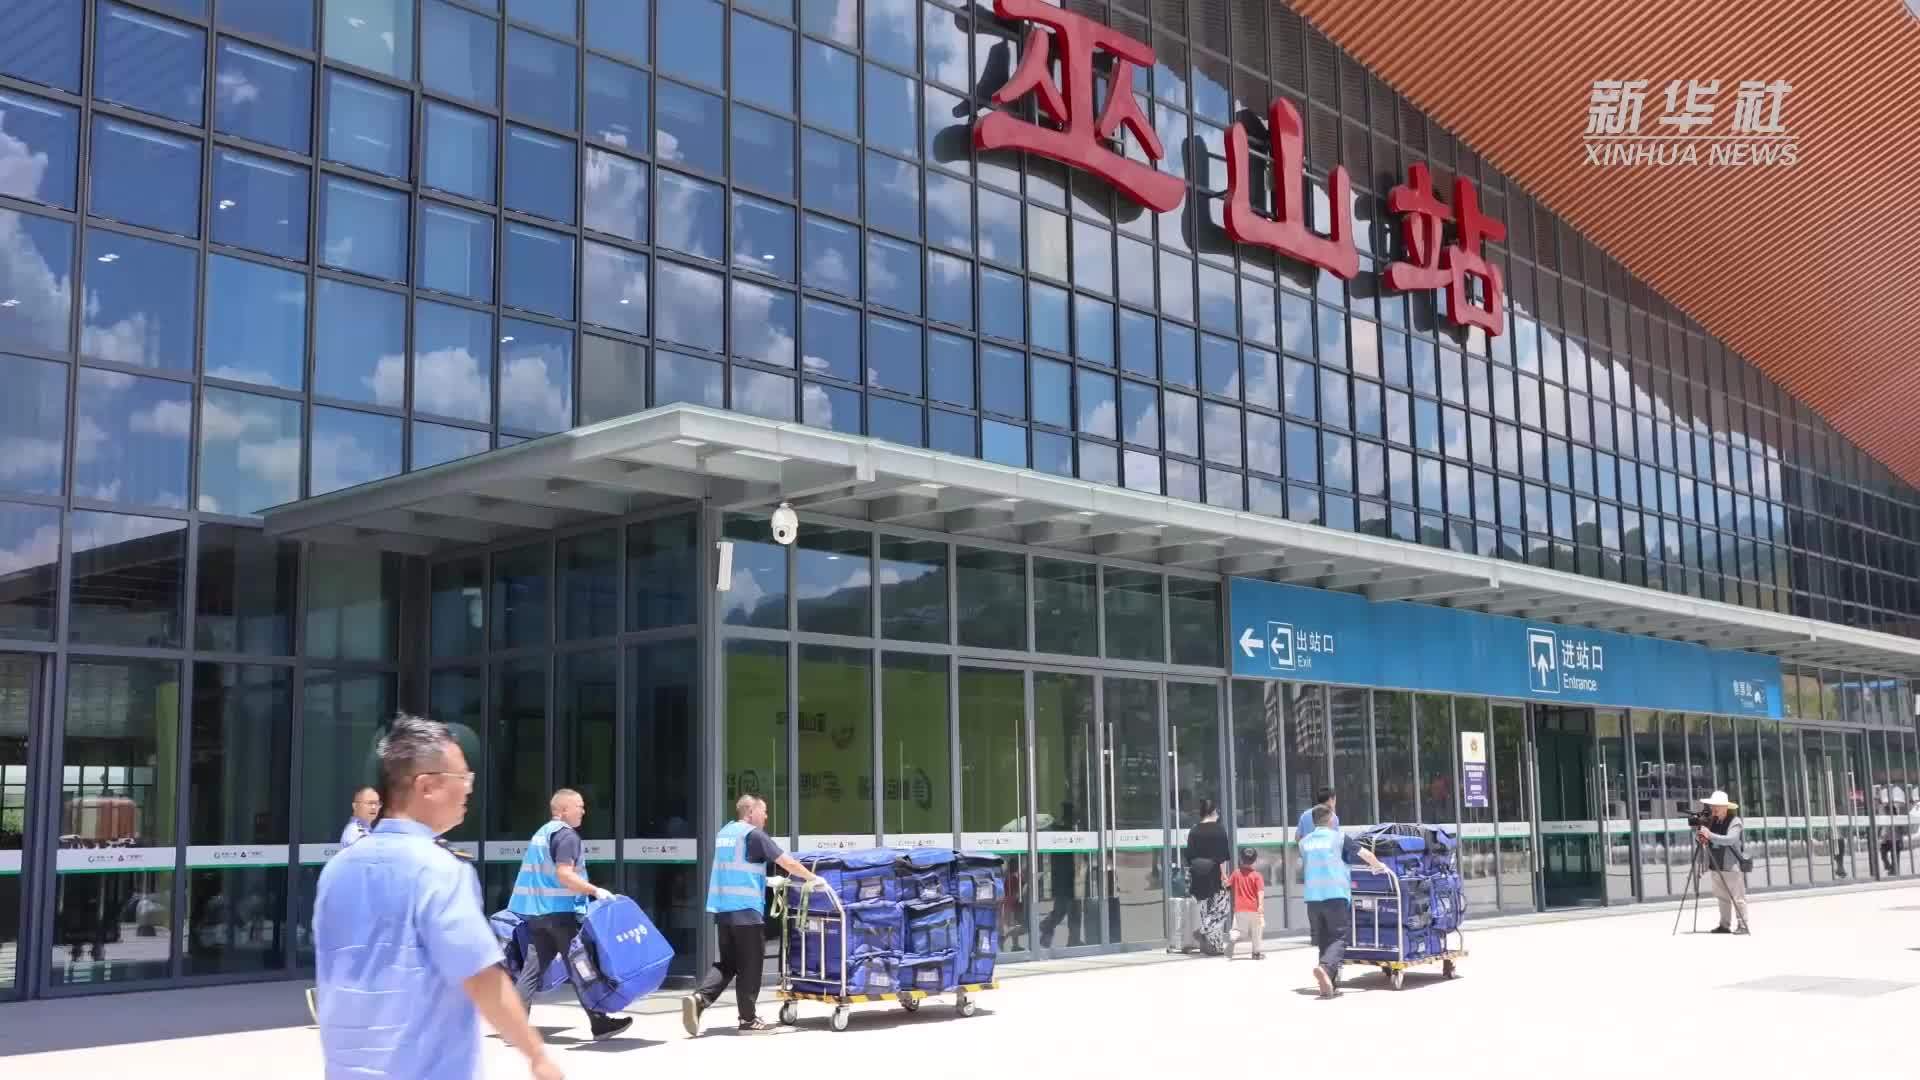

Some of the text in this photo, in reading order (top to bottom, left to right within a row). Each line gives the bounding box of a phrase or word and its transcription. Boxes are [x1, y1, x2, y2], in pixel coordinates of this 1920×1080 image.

[974, 0, 1506, 337] 巫山站
[1296, 630, 1334, 653] 出站口
[1297, 655, 1312, 668] Exit
[1561, 639, 1604, 672] 进站口
[1563, 673, 1598, 692] Entrance
